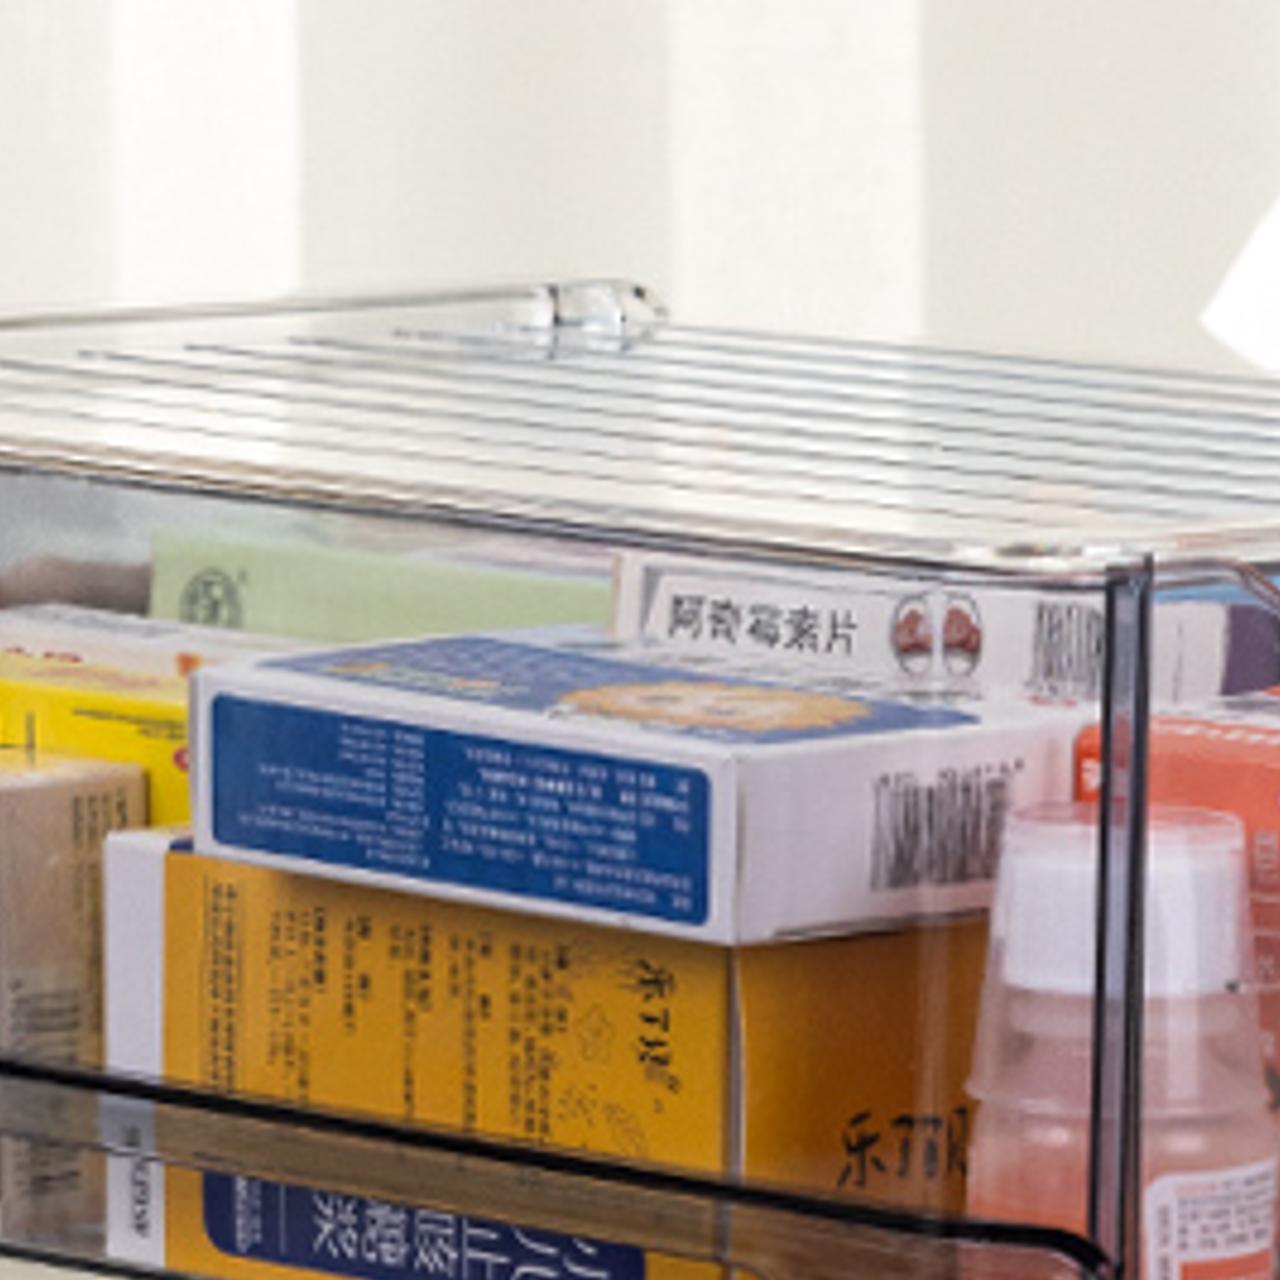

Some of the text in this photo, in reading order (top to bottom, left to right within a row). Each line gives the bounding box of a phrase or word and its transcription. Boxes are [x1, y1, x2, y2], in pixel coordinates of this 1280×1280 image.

[668, 594, 858, 655] 阿奇霉素片
